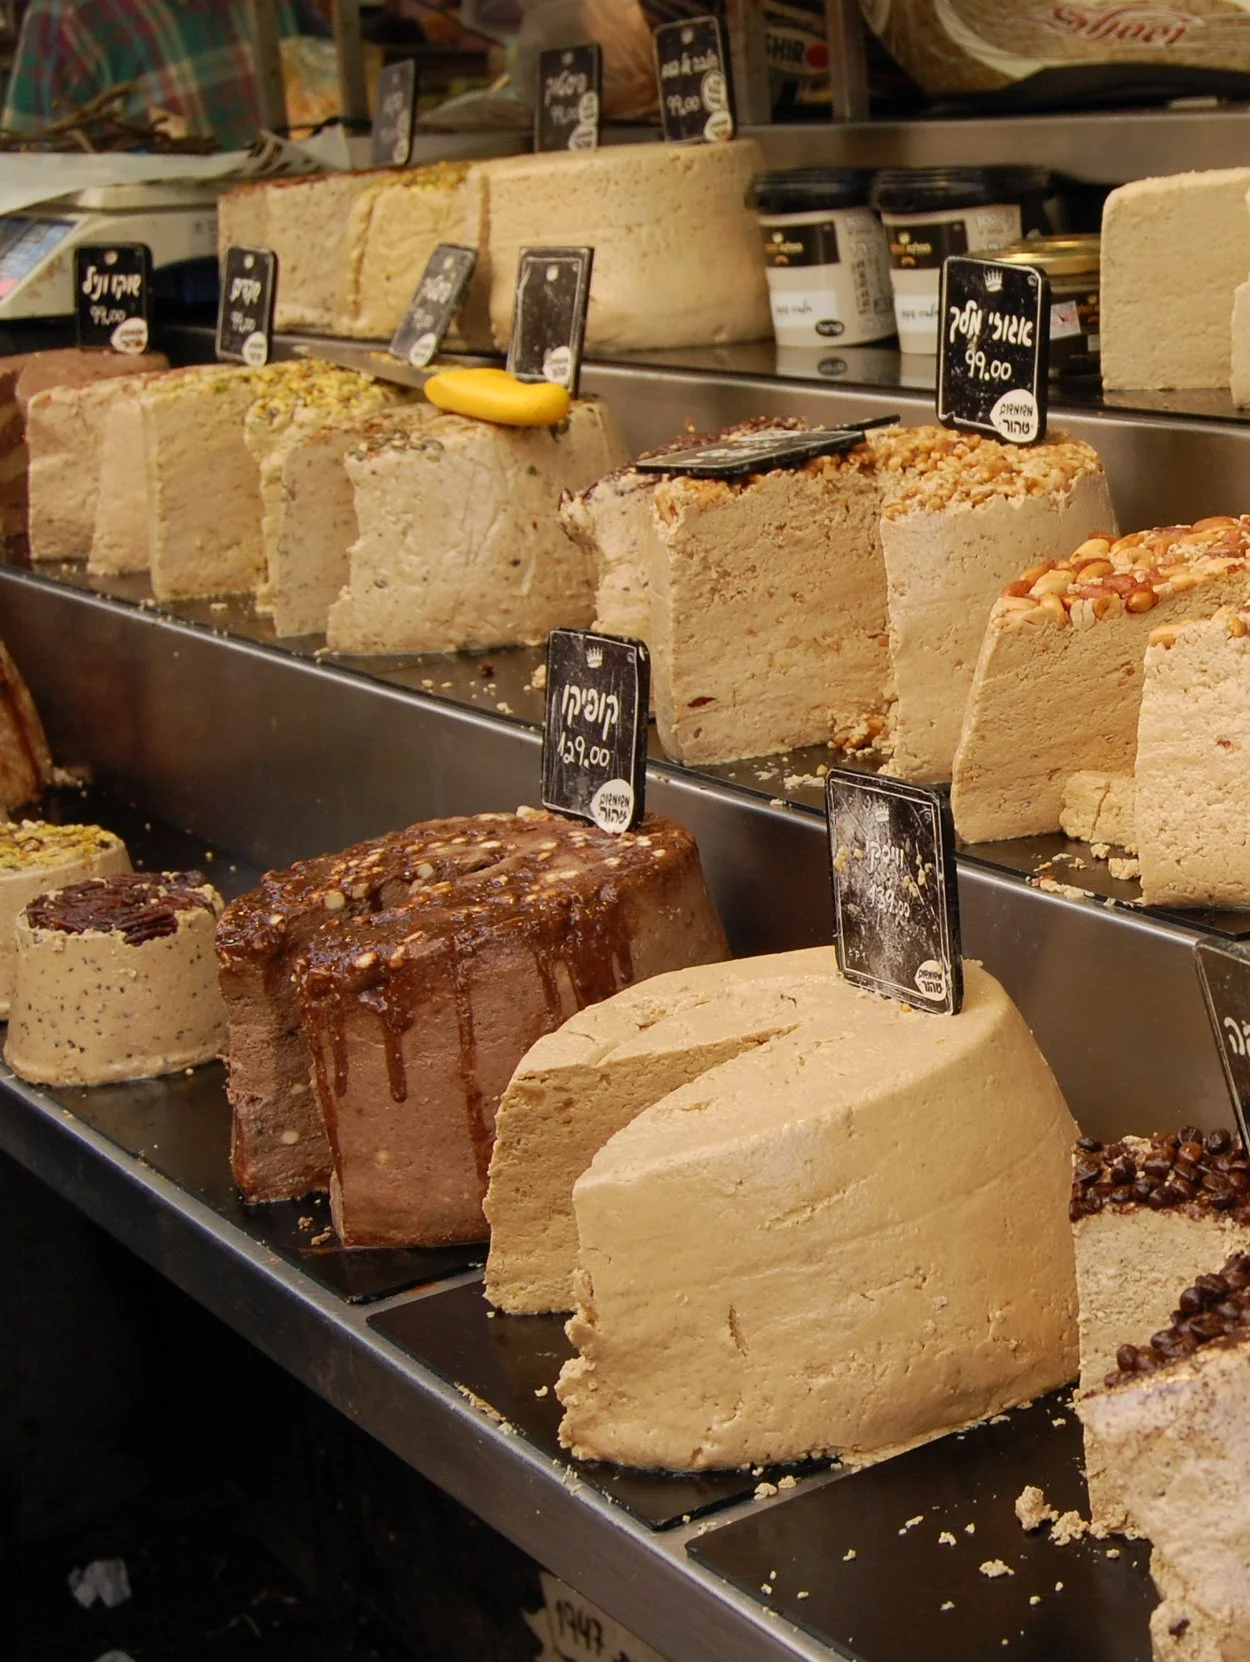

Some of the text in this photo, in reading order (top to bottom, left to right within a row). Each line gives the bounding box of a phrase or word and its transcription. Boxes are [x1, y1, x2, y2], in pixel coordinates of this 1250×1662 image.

[950, 300, 1033, 347] אגוזי מלך
[965, 350, 1012, 381] 99.00
[999, 402, 1033, 417] משומשום
[1002, 419, 1031, 434] טהור
[562, 684, 618, 741] קופיקו
[557, 731, 610, 768] 129.00
